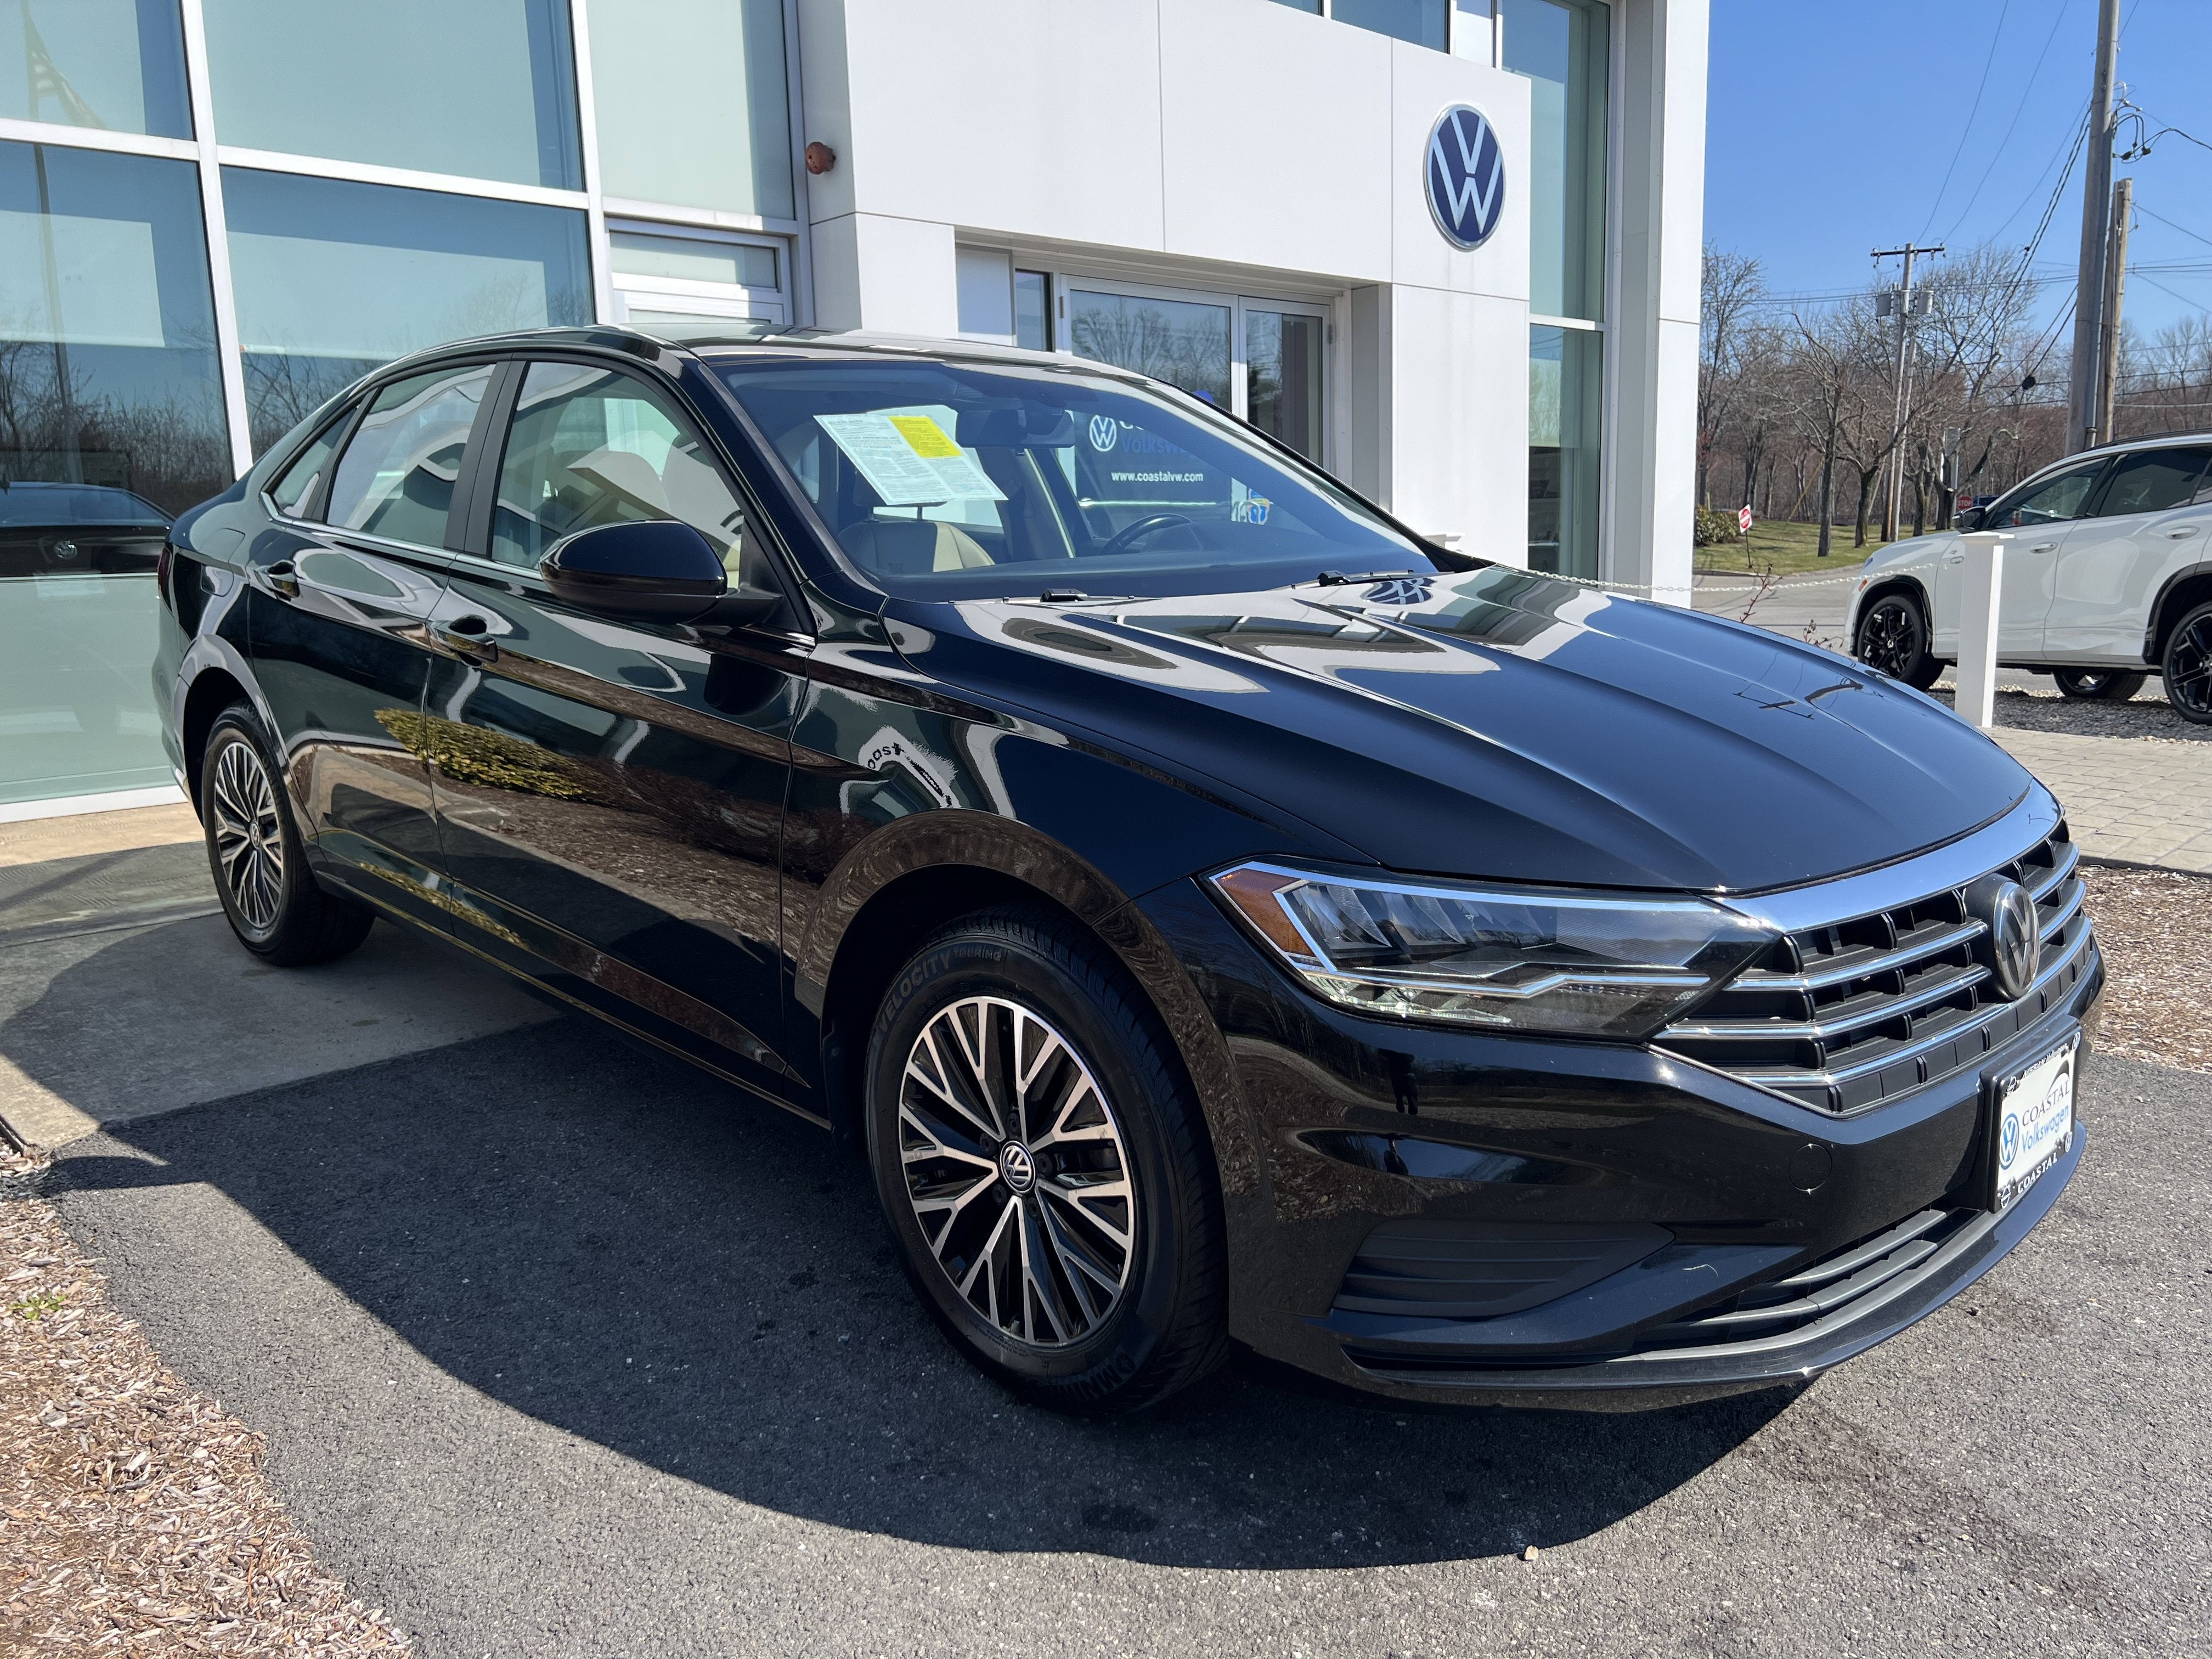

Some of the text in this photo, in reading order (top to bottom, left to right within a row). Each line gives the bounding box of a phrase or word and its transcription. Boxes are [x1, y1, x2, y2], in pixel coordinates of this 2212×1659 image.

[1426, 104, 1506, 248] VW
[1090, 415, 1117, 452] VW
[1111, 471, 1204, 482] www.coastalvw.com
[878, 953, 951, 1032] VELOCITY
[953, 947, 1002, 962] TOURING
[2022, 1079, 2070, 1126] COASTAL
[1999, 1113, 2020, 1170] VW
[2022, 1104, 2069, 1153] Volkswagen
[2017, 1152, 2058, 1194] COASTAL
